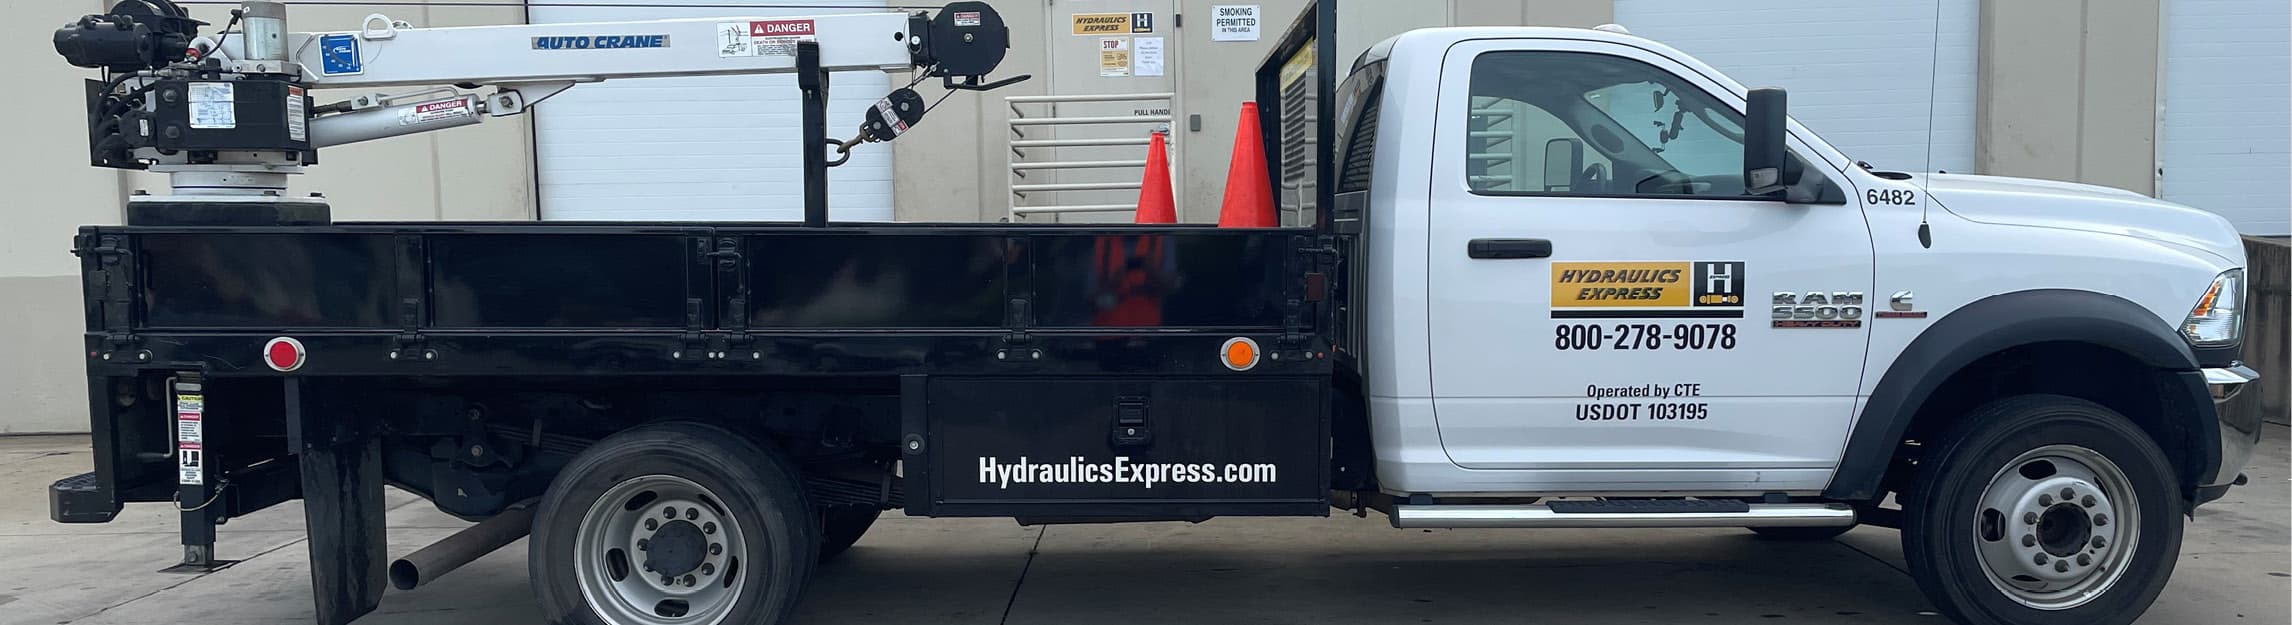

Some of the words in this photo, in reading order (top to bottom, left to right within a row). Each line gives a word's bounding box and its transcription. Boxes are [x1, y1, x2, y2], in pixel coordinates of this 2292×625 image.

[1219, 8, 1253, 16] SMOKING
[767, 23, 811, 33] DANGER
[1083, 24, 1120, 32] EXPRESS
[1216, 18, 1256, 27] PERMITTED
[536, 36, 590, 49] AUTO
[594, 35, 663, 49] CRANE
[1103, 40, 1119, 49] STOP
[429, 100, 462, 111] DANGER
[1866, 188, 1916, 205] 6482
[1559, 269, 1682, 283] HYDRAULICS
[1707, 263, 1732, 293] H
[1576, 286, 1664, 301] EXPRESS
[1772, 291, 1863, 305] RAM
[1771, 305, 1863, 320] 5500
[1555, 323, 1737, 350] 800-278-9078
[1587, 384, 1650, 400] Operated
[1654, 384, 1670, 399] by
[1674, 383, 1701, 397] CTE
[1576, 403, 1642, 421] USDOT
[1647, 403, 1708, 420] 103195
[979, 456, 1277, 488] HydraulicsExpress.com
